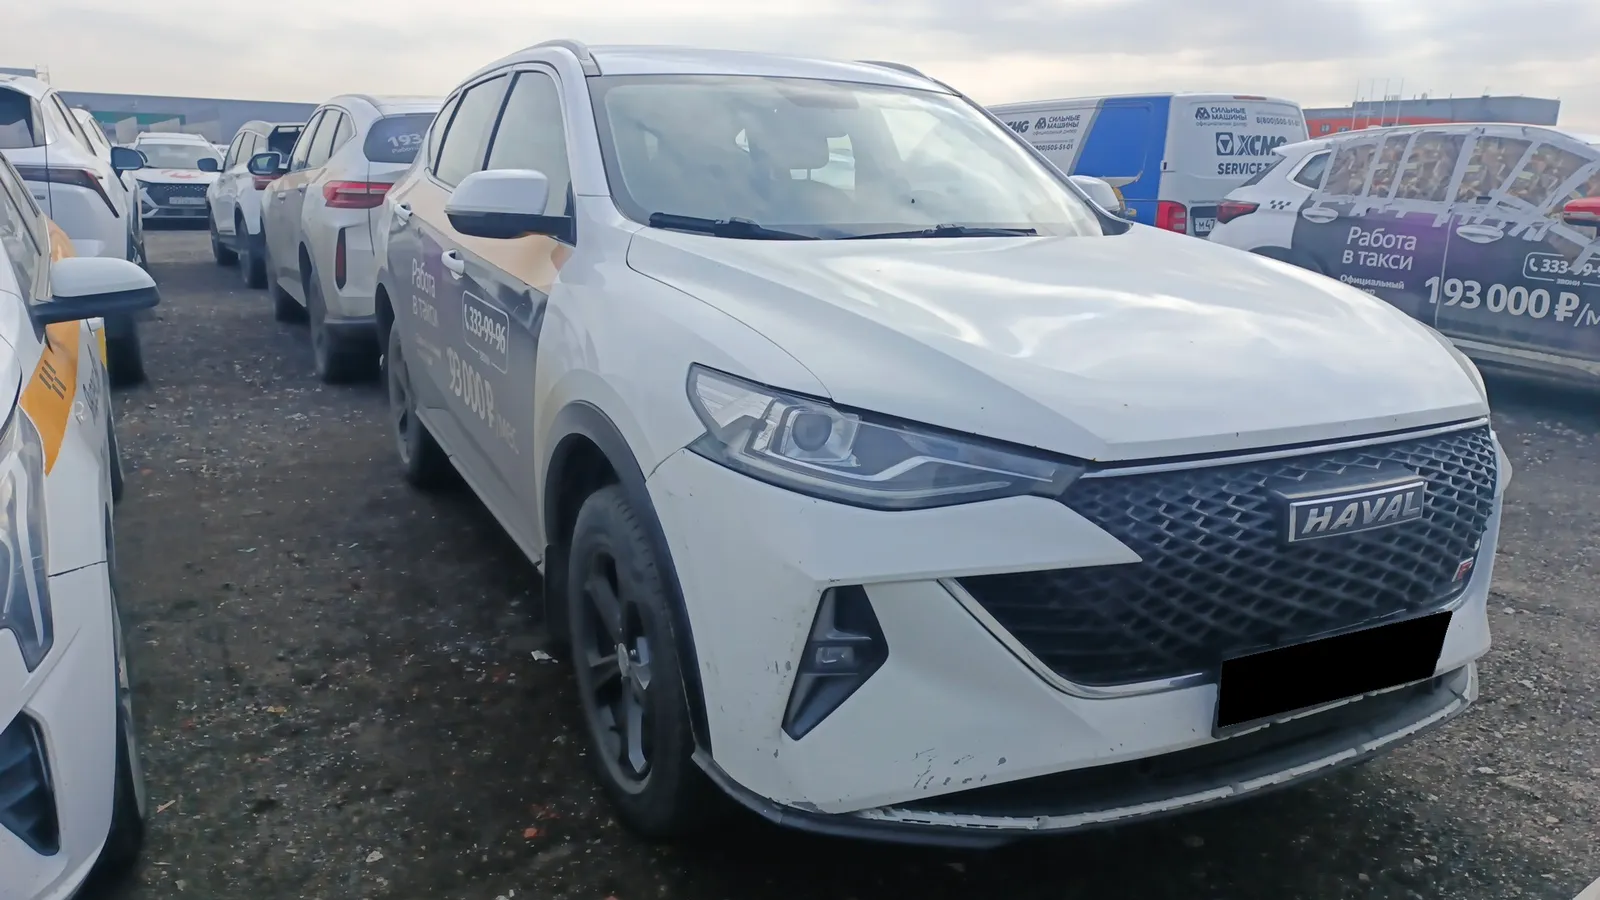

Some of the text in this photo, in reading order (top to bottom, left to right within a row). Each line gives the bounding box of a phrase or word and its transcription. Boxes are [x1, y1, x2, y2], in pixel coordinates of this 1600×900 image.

[388, 133, 423, 146] 193
[1217, 163, 1263, 175] SERVICE
[1347, 226, 1417, 250] Работа
[1342, 250, 1414, 271] в такси
[411, 258, 436, 298] Работа
[1340, 274, 1405, 289] Официальный
[1424, 277, 1482, 309] 193
[1486, 284, 1551, 319] 000
[469, 306, 506, 354] 333-99-96
[462, 360, 485, 420] 000
[1302, 491, 1421, 534] HAVAL
